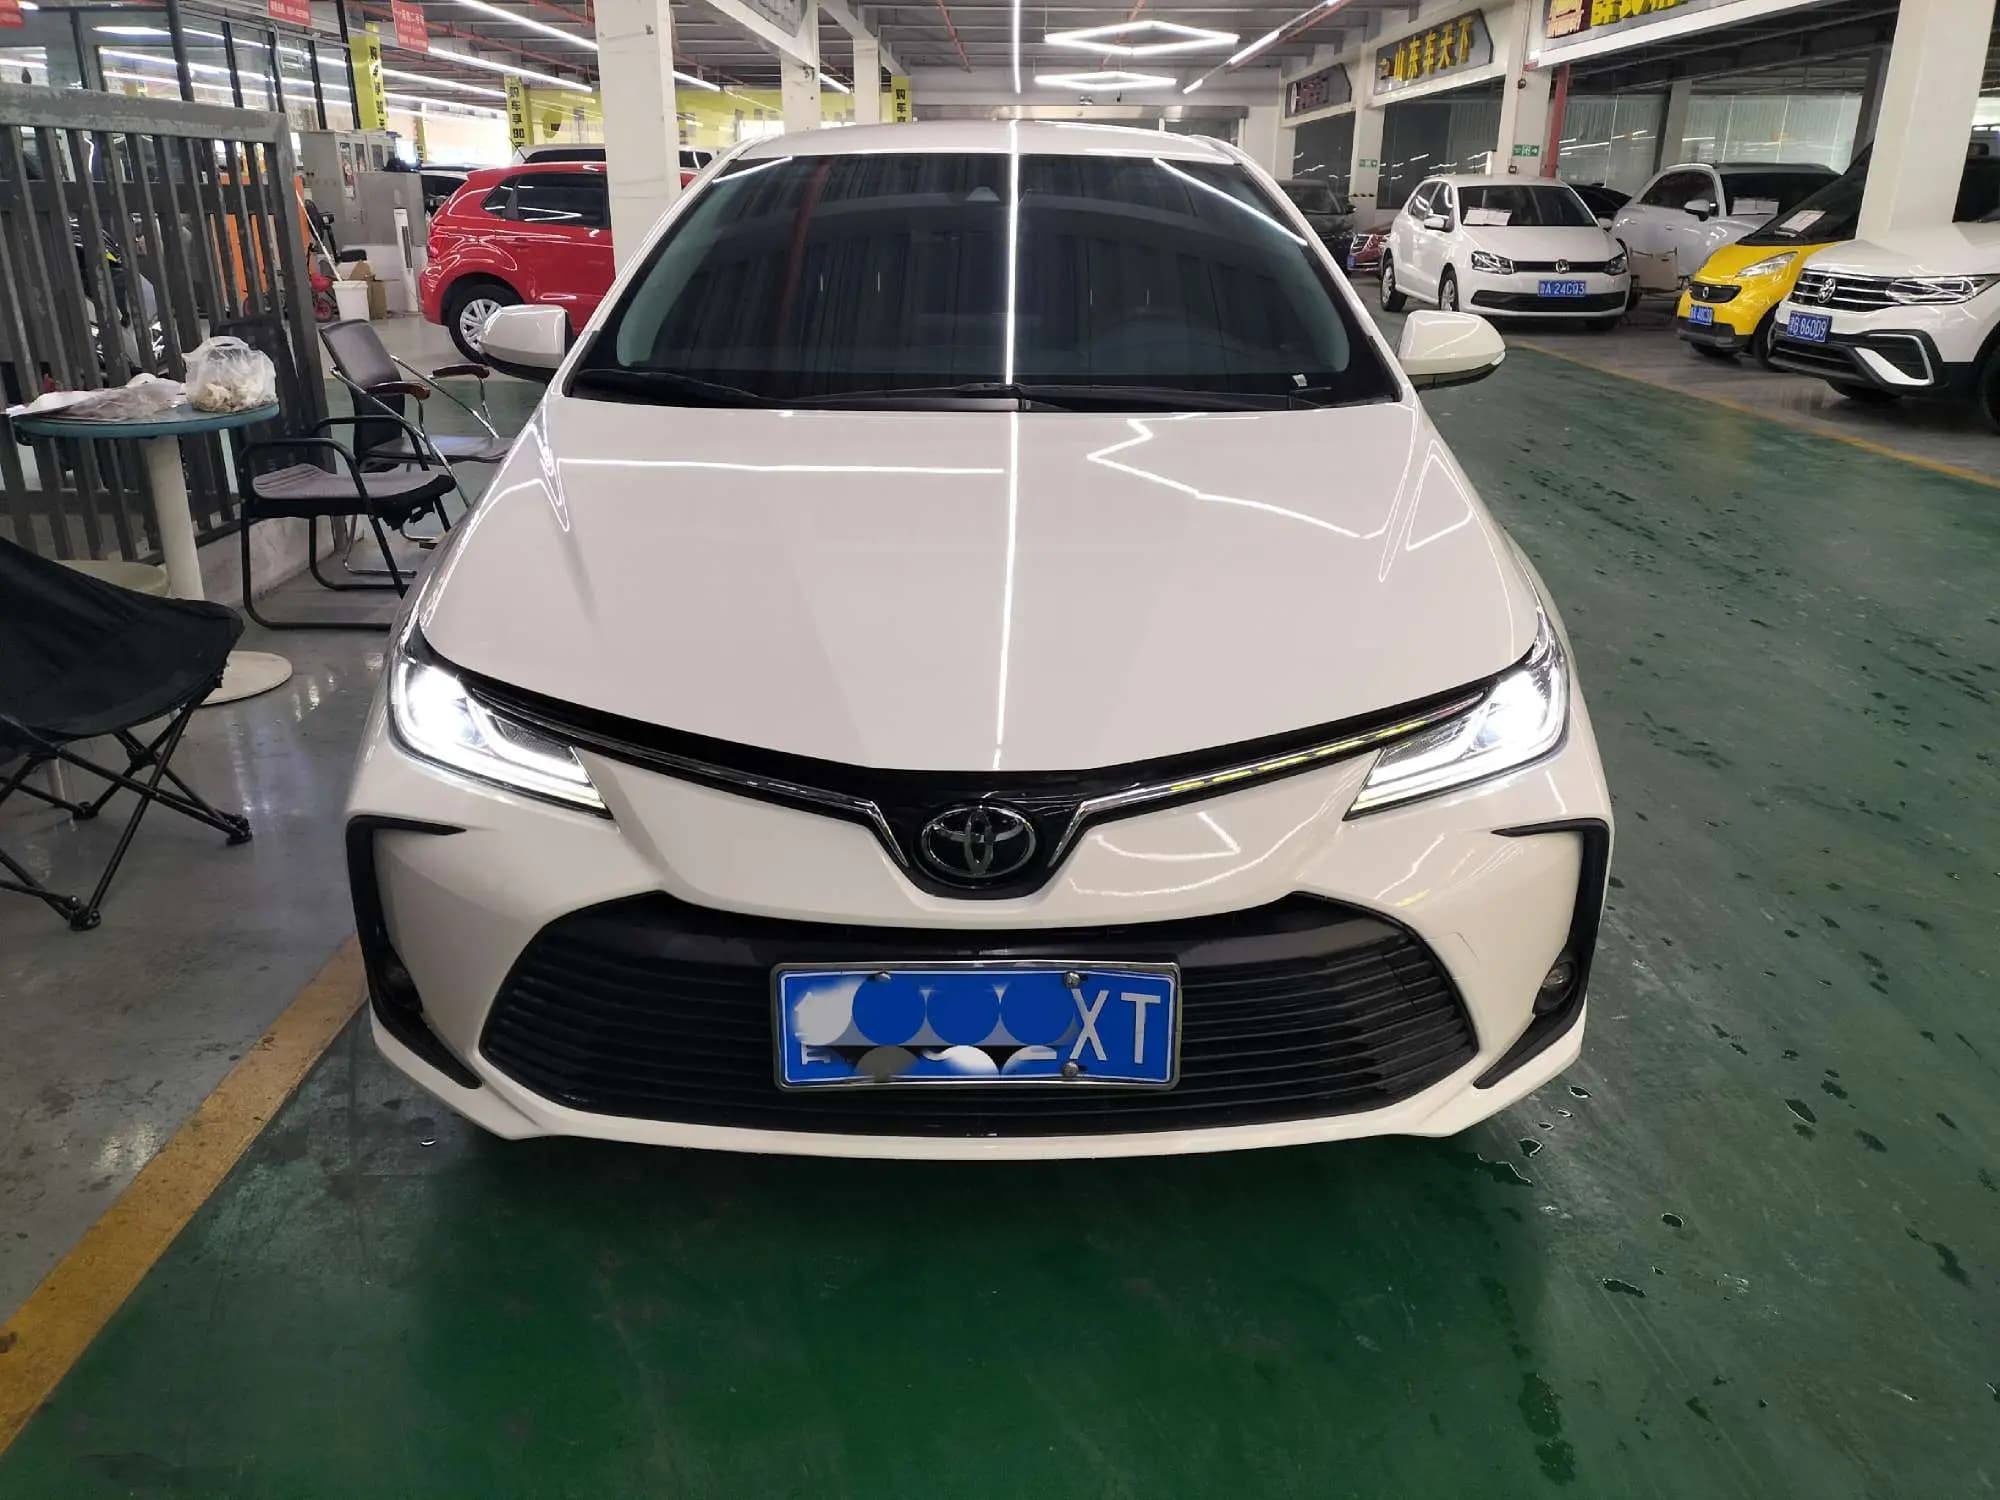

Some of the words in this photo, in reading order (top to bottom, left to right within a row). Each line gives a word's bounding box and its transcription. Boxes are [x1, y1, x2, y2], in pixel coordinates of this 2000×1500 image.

[1394, 16, 1473, 81] 山东车天下
